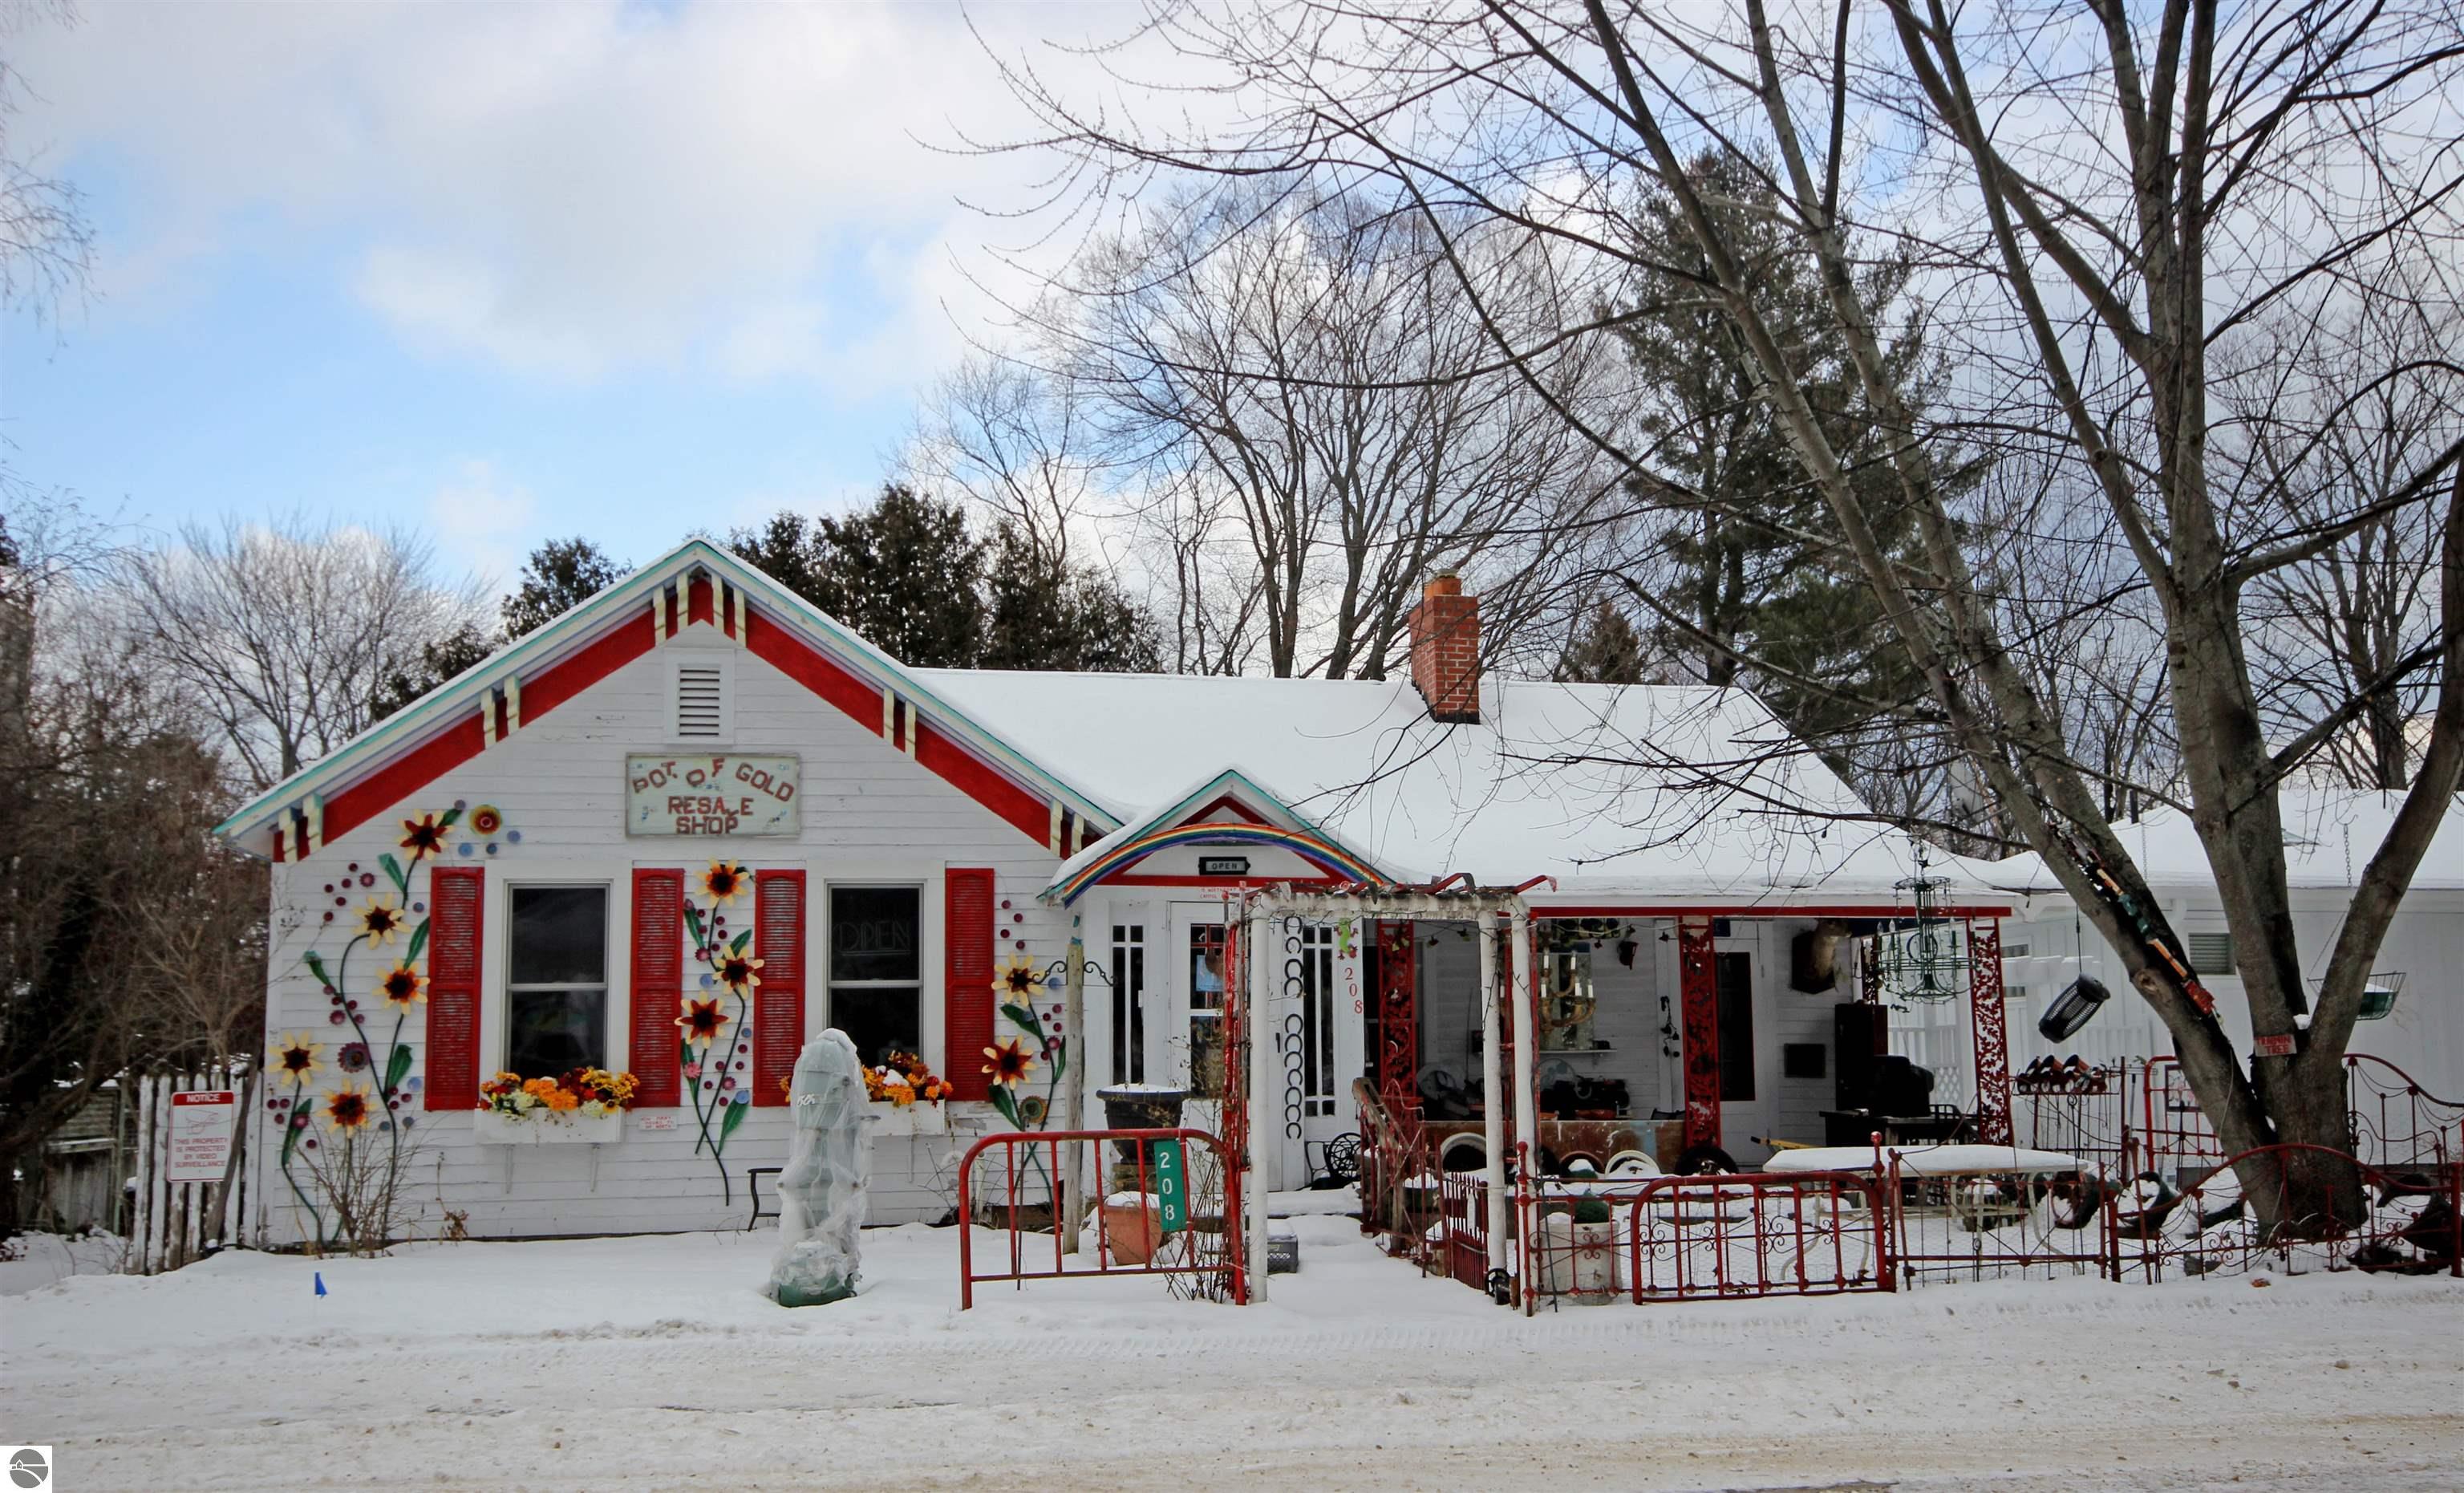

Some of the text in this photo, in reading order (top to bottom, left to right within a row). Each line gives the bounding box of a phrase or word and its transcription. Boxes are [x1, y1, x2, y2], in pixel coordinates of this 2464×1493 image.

[686, 757, 725, 787] OF
[736, 762, 796, 802] GOLD
[667, 796, 754, 817] RESALE
[675, 816, 739, 835] SHOP
[1212, 862, 1238, 870] OPEN
[833, 919, 911, 951] OPEN
[1344, 968, 1363, 1014] 208
[187, 1093, 221, 1102] NOTICE
[174, 1160, 225, 1168] SURVEILLANCE
[1160, 1152, 1175, 1220] 208
